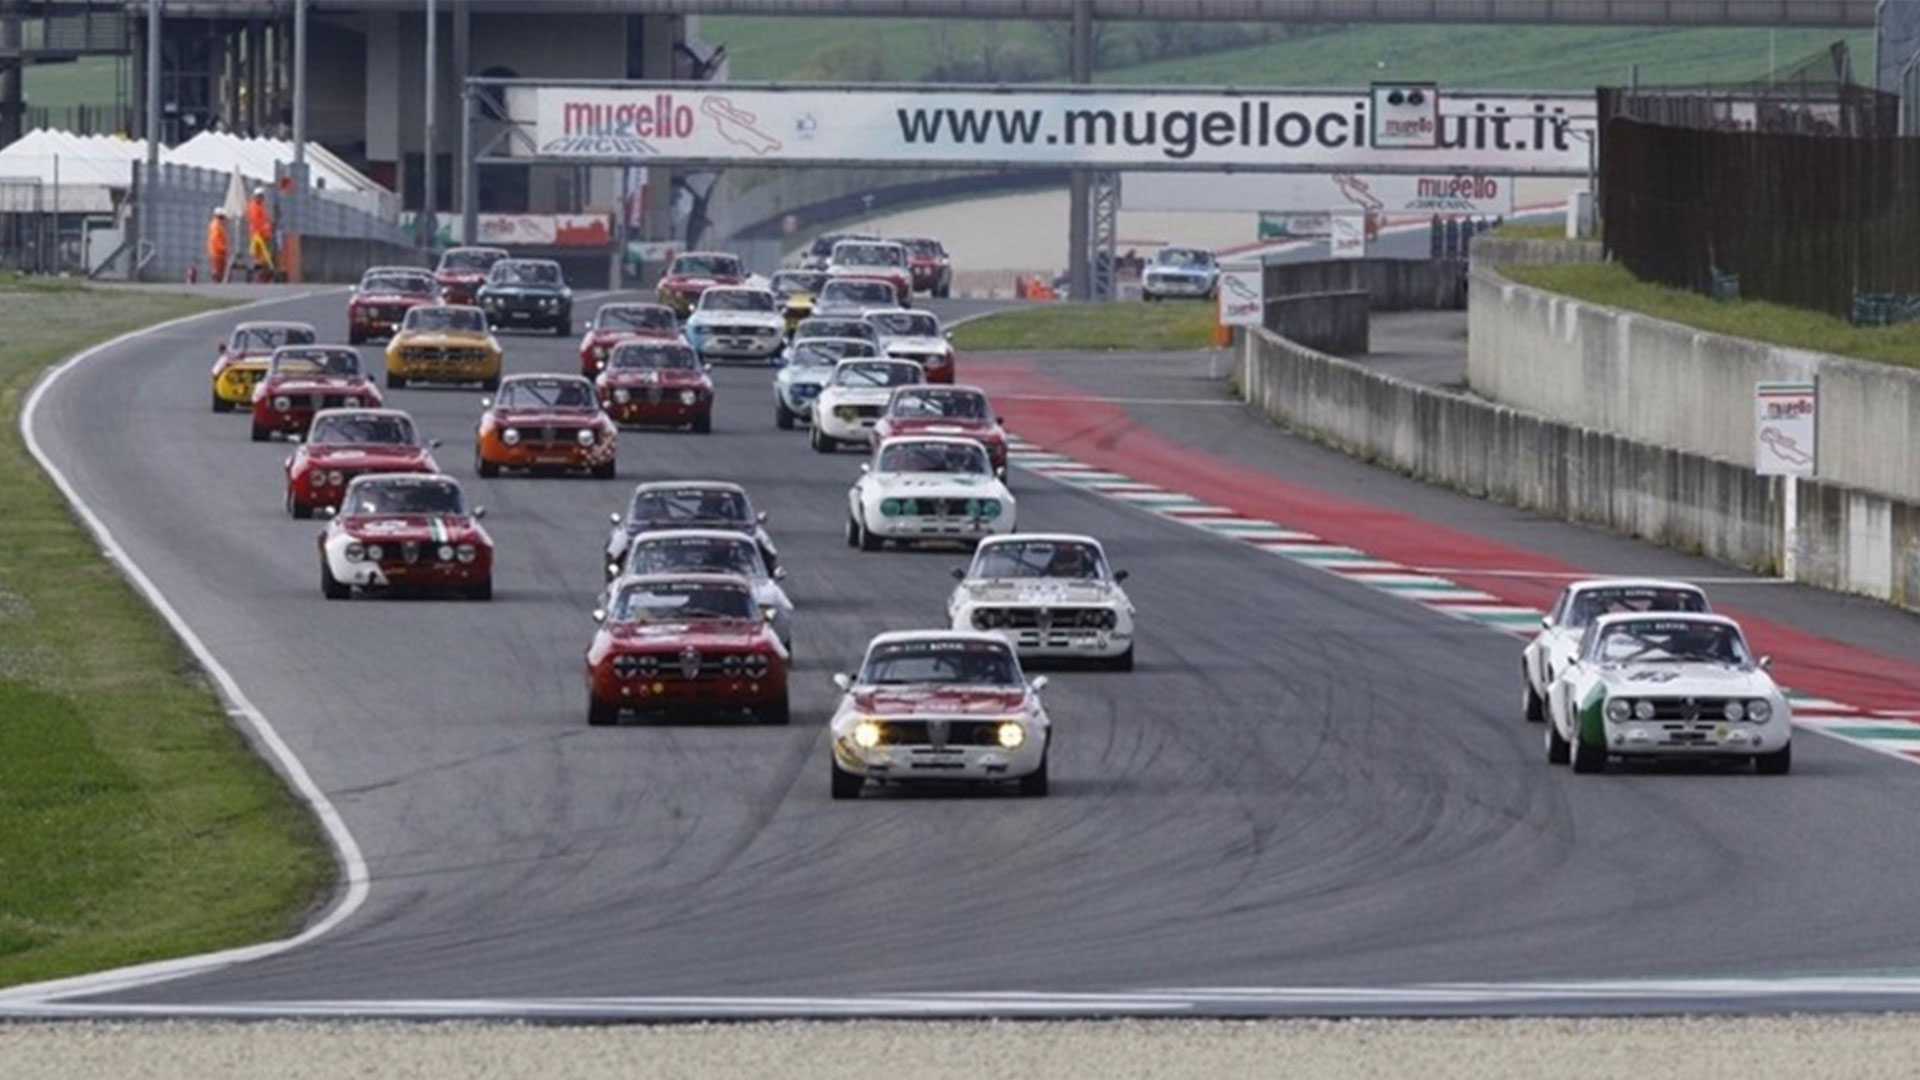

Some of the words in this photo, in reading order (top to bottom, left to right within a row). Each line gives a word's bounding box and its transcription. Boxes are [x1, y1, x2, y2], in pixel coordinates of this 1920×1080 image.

[564, 95, 694, 138] mugello
[897, 101, 1569, 158] www.mugellociuit.it
[1417, 173, 1497, 199] mugello
